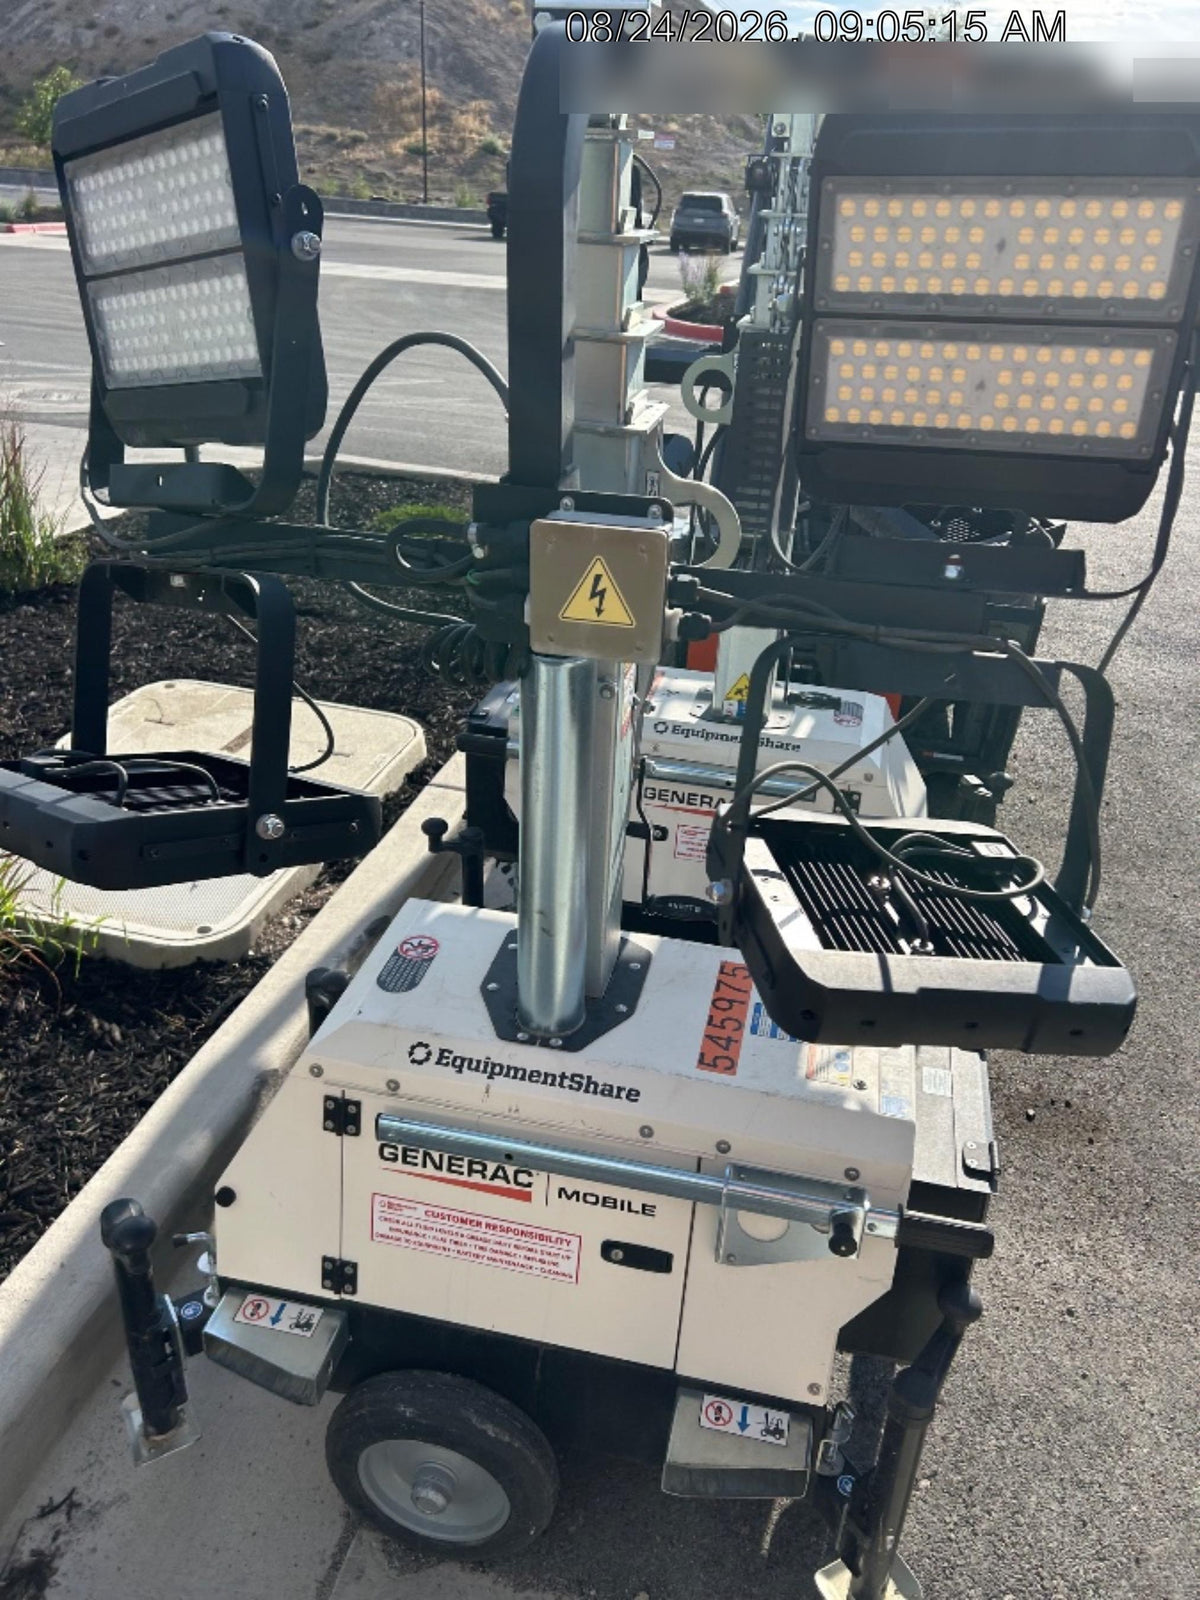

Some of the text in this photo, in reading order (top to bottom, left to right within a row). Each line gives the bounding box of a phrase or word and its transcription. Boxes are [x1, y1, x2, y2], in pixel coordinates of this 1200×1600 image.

[643, 786, 732, 810] GENERA
[698, 963, 750, 1072] 545975
[435, 1048, 641, 1103] EquipmentShare
[378, 1142, 657, 1218] GENERAC MOBILE
[423, 1208, 571, 1247] CUSTOMER RESPONSIBILITY
